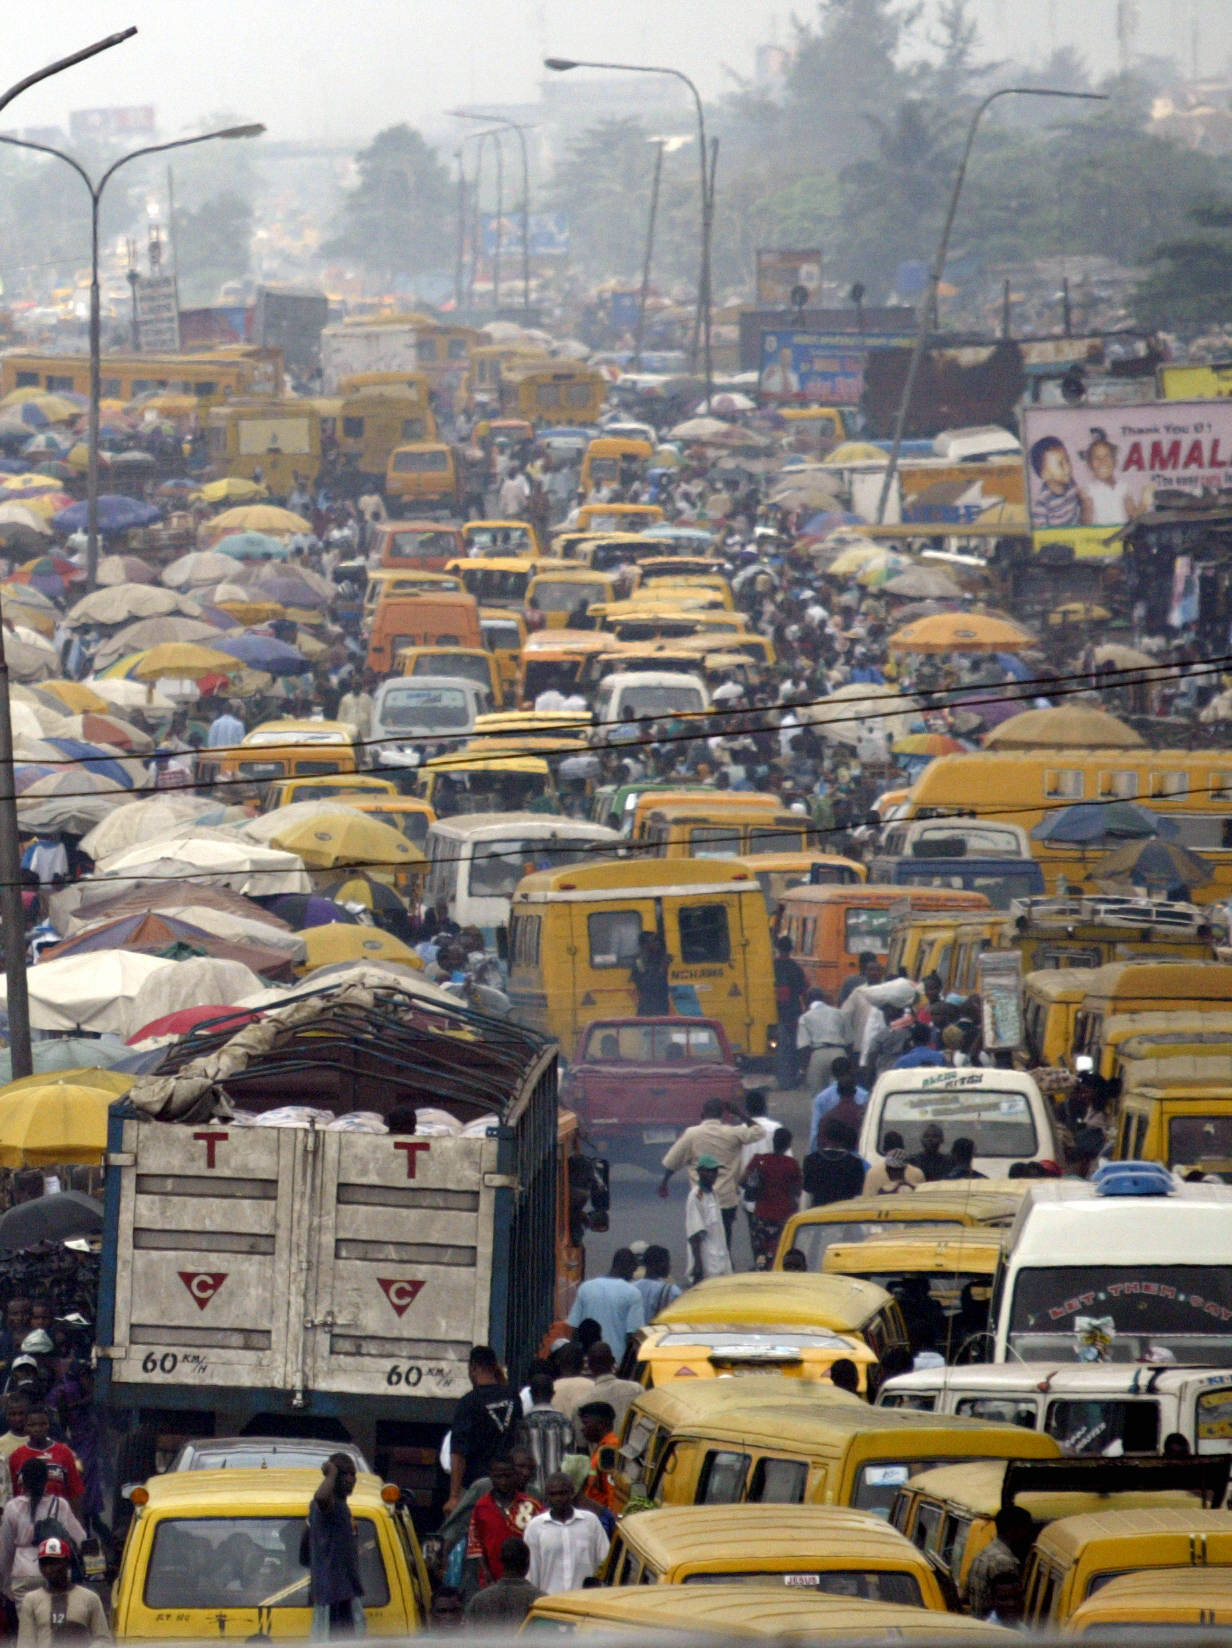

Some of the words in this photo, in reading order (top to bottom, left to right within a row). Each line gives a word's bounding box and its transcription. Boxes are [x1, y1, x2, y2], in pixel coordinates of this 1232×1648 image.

[1122, 438, 1232, 472] AMAL
[193, 1132, 229, 1169] T
[394, 1142, 430, 1179] T
[191, 1275, 215, 1299] C
[388, 1281, 413, 1306] C
[1048, 1291, 1096, 1321] LET
[1107, 1281, 1177, 1299] THEM
[142, 1351, 178, 1374] 60
[386, 1364, 422, 1387] 60
[515, 1501, 535, 1530] 8
